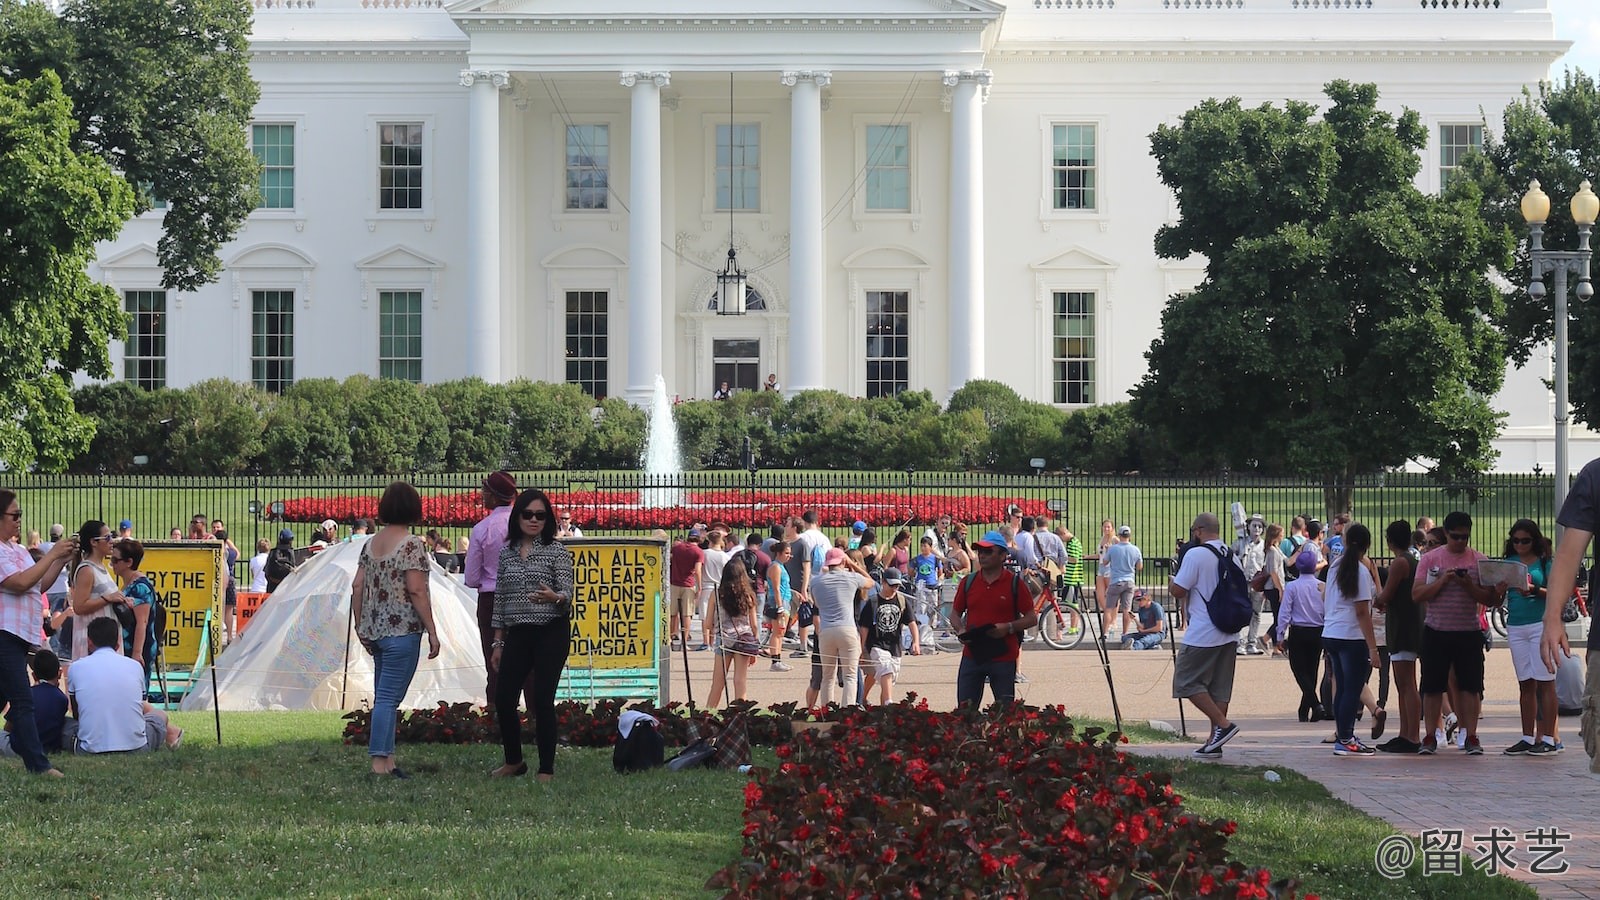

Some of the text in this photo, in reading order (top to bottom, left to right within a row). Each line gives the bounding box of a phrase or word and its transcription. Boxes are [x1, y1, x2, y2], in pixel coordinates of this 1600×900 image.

[612, 549, 644, 566] ALL
[171, 572, 205, 588] THE
[572, 567, 645, 585] UCLEAR
[248, 597, 259, 606] IT
[571, 585, 644, 603] EAPONS
[171, 611, 205, 628] THE
[213, 604, 219, 621] IS
[599, 603, 645, 620] HAVE
[599, 621, 638, 638] NICE
[569, 639, 649, 656] OOMSDAY
